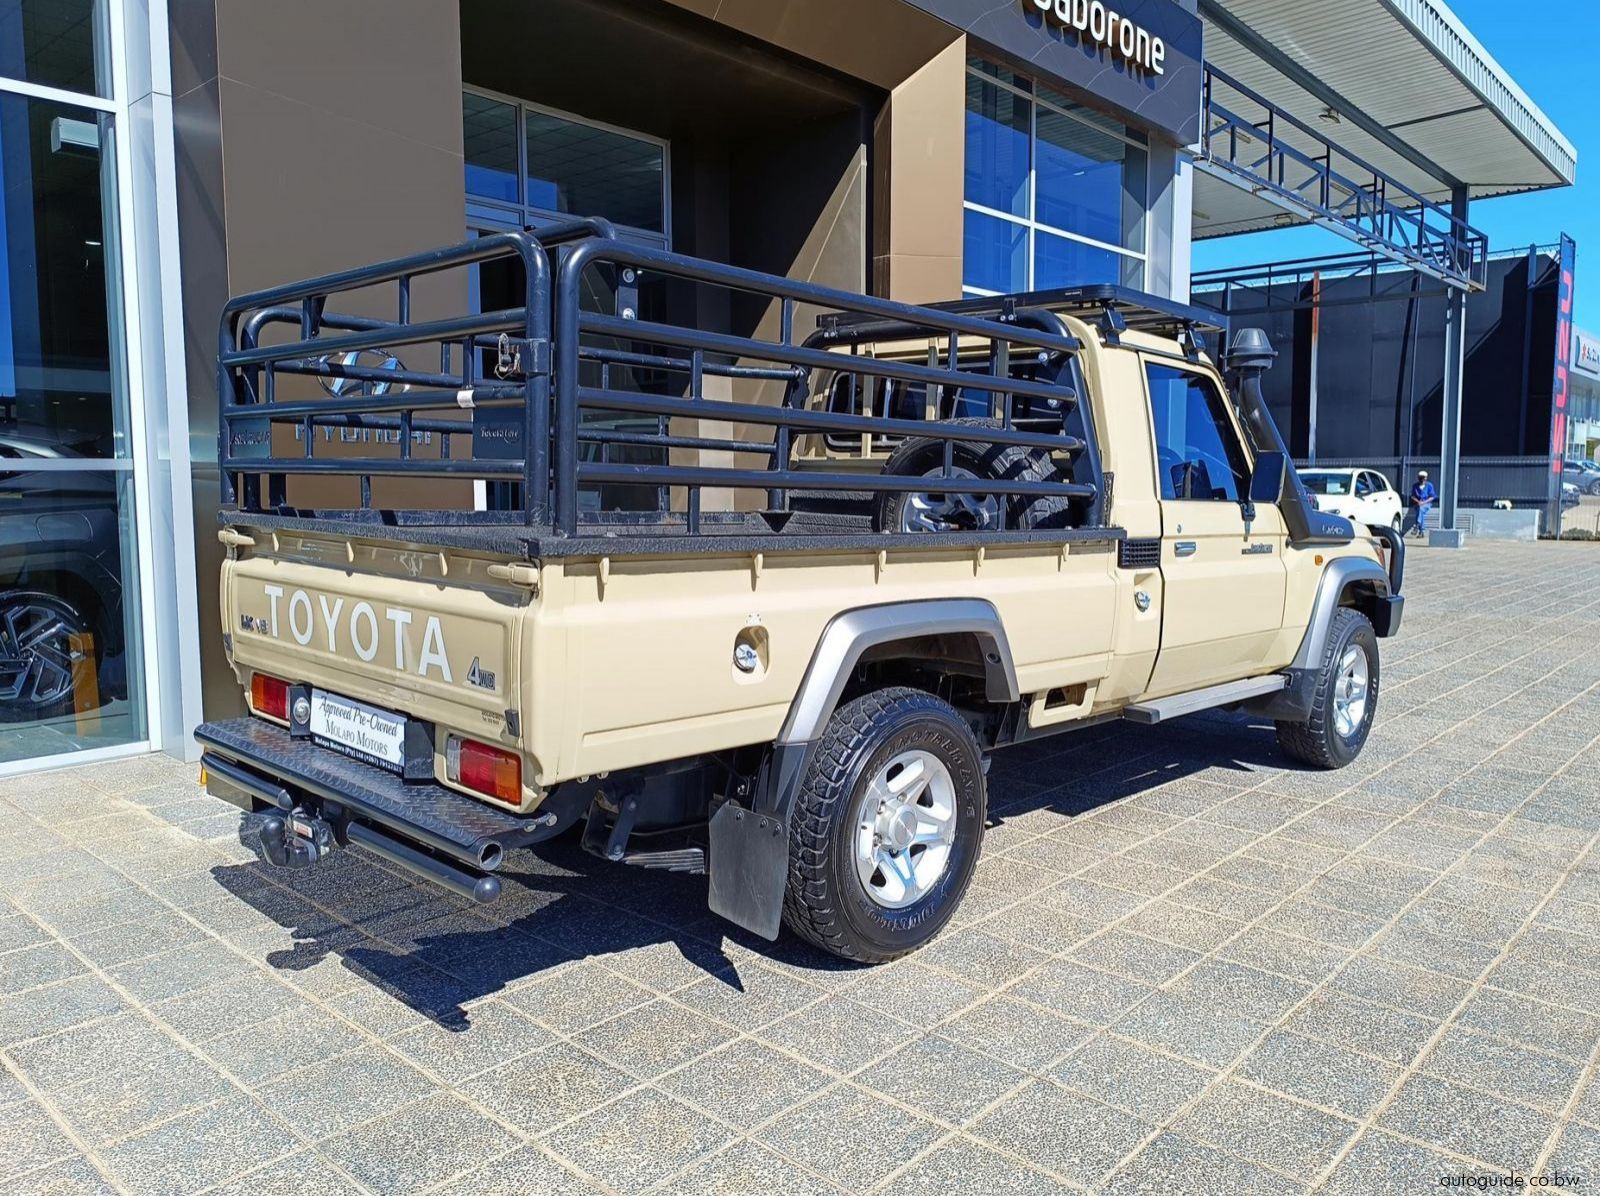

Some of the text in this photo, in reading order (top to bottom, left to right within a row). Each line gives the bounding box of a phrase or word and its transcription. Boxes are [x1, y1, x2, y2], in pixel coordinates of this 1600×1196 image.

[1033, 0, 1165, 75] aborone
[264, 584, 452, 682] TOYOTA
[320, 696, 399, 737] Approved Pre-Owned
